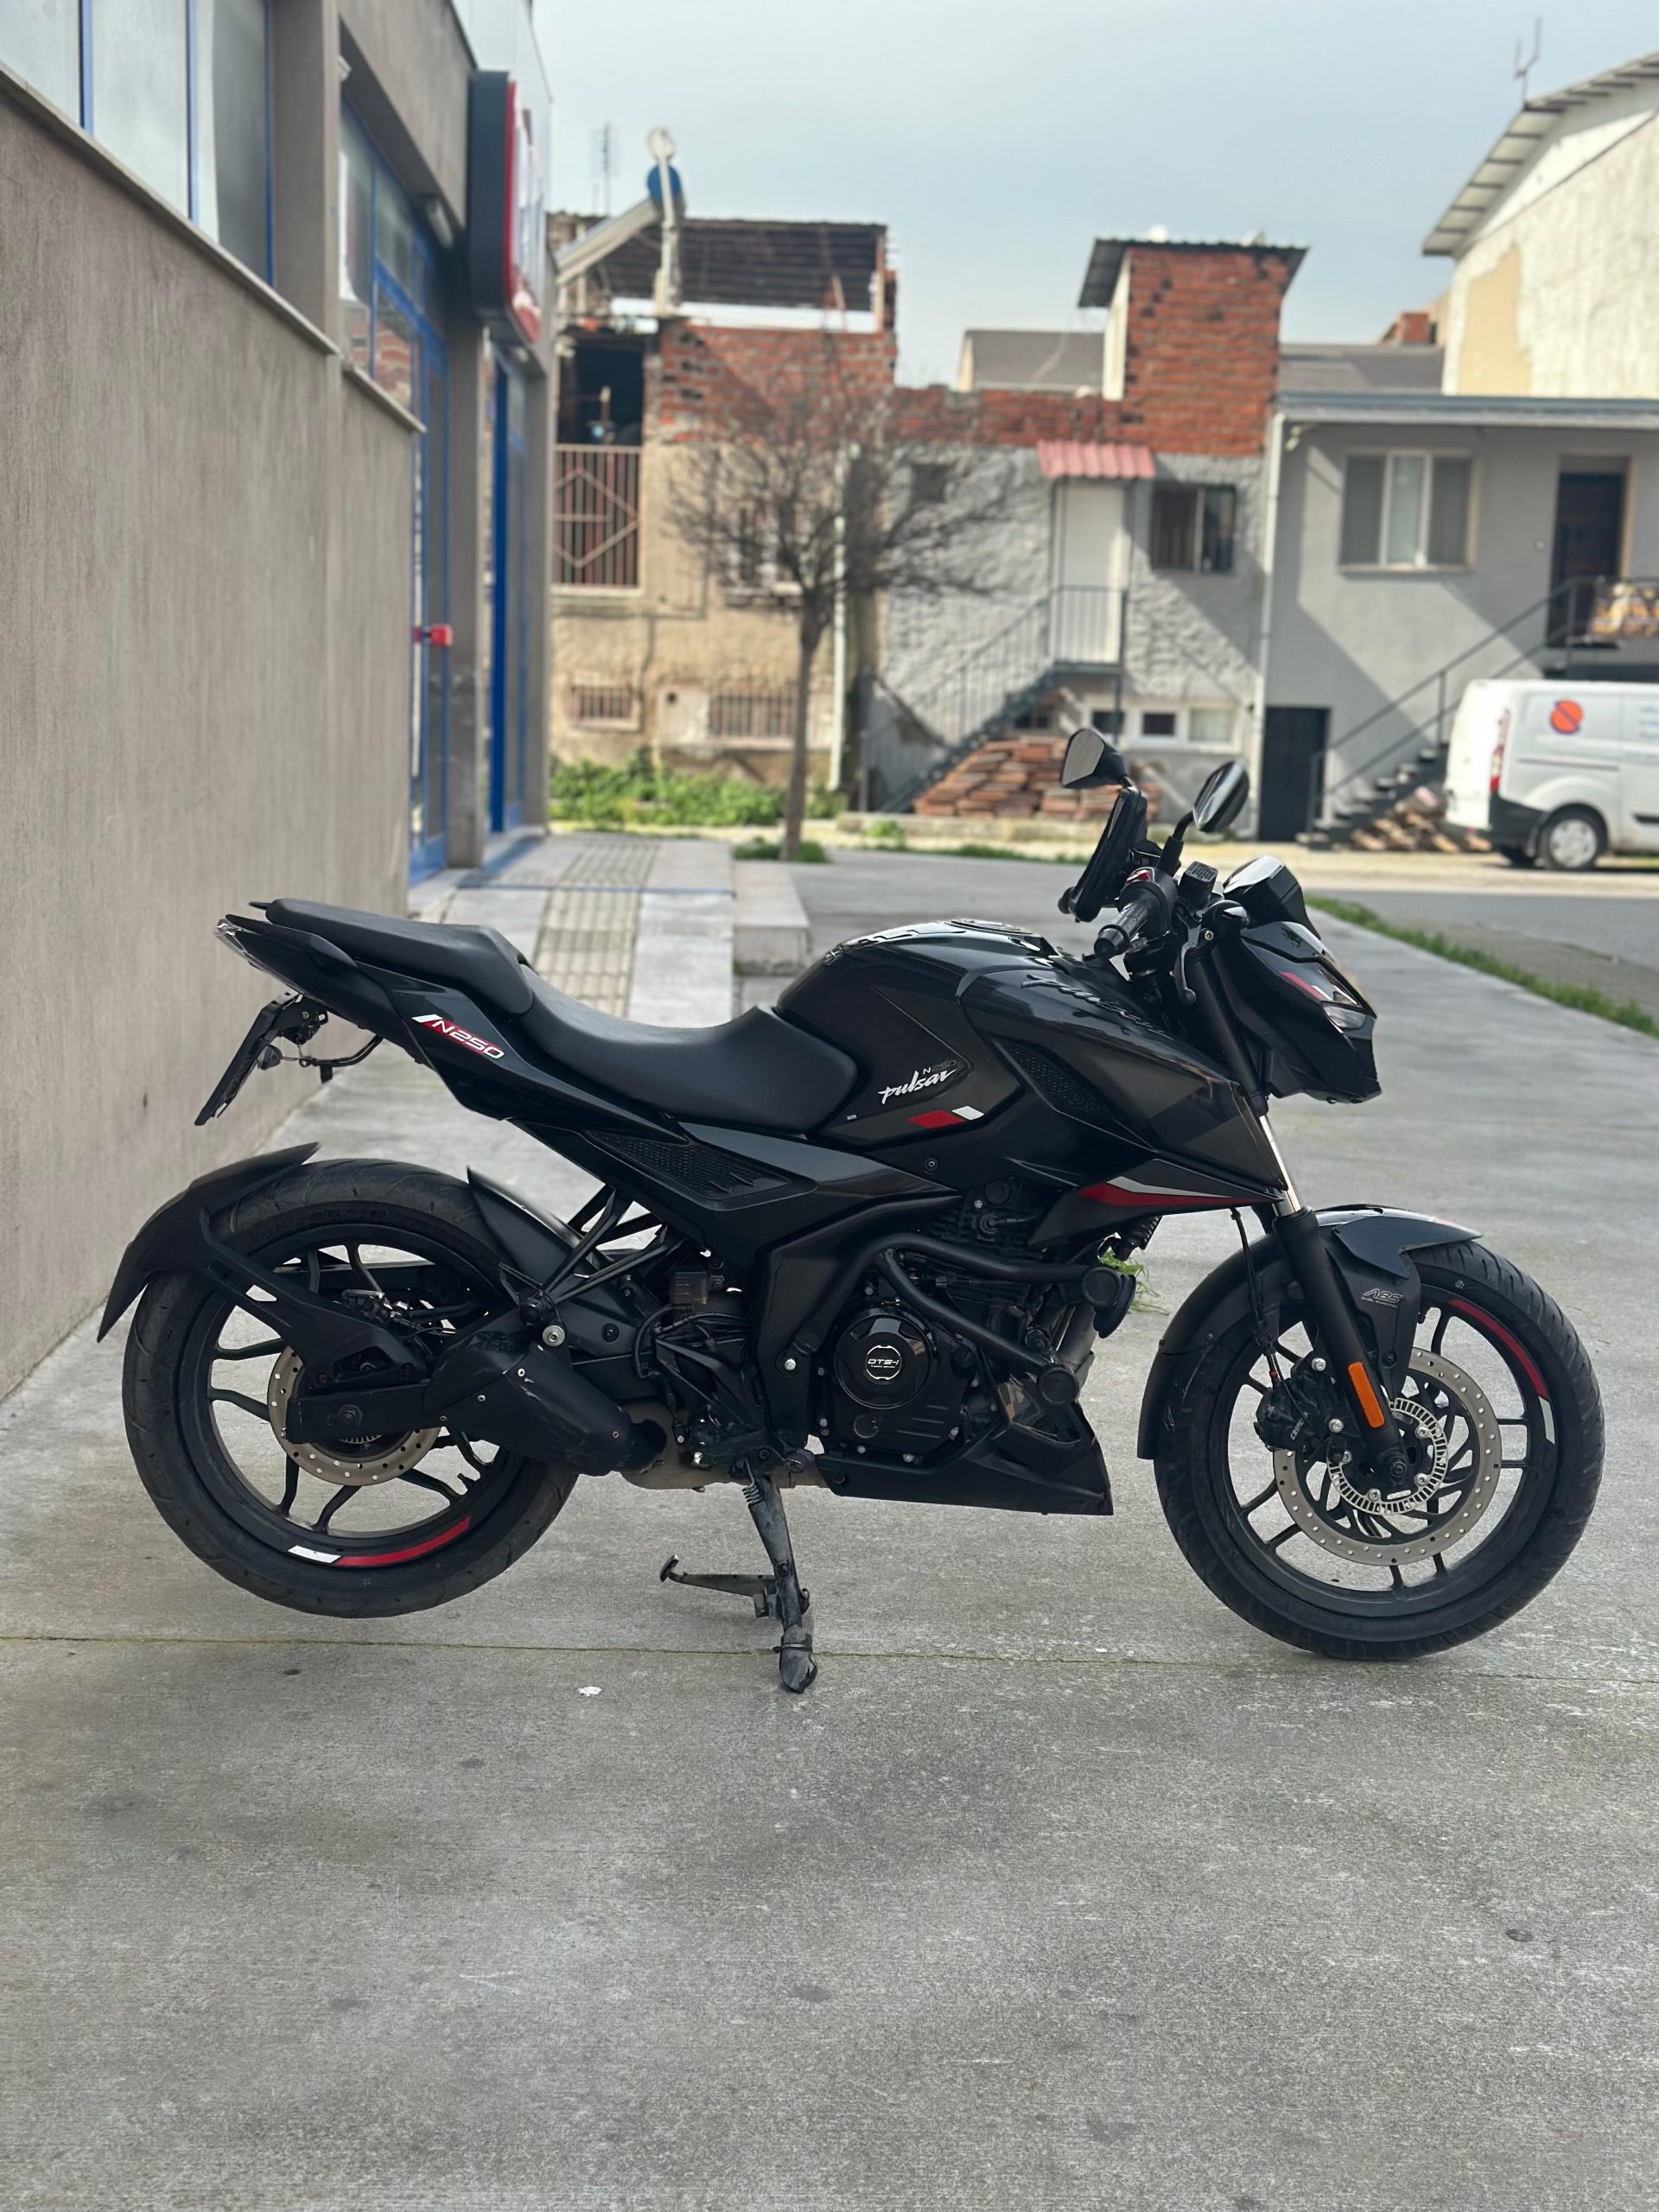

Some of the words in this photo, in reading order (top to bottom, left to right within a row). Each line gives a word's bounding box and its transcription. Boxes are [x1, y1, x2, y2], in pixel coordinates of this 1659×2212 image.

[432, 1020, 505, 1059] N250
[878, 1069, 957, 1105] pulsar
[1363, 1287, 1403, 1304] ABS
